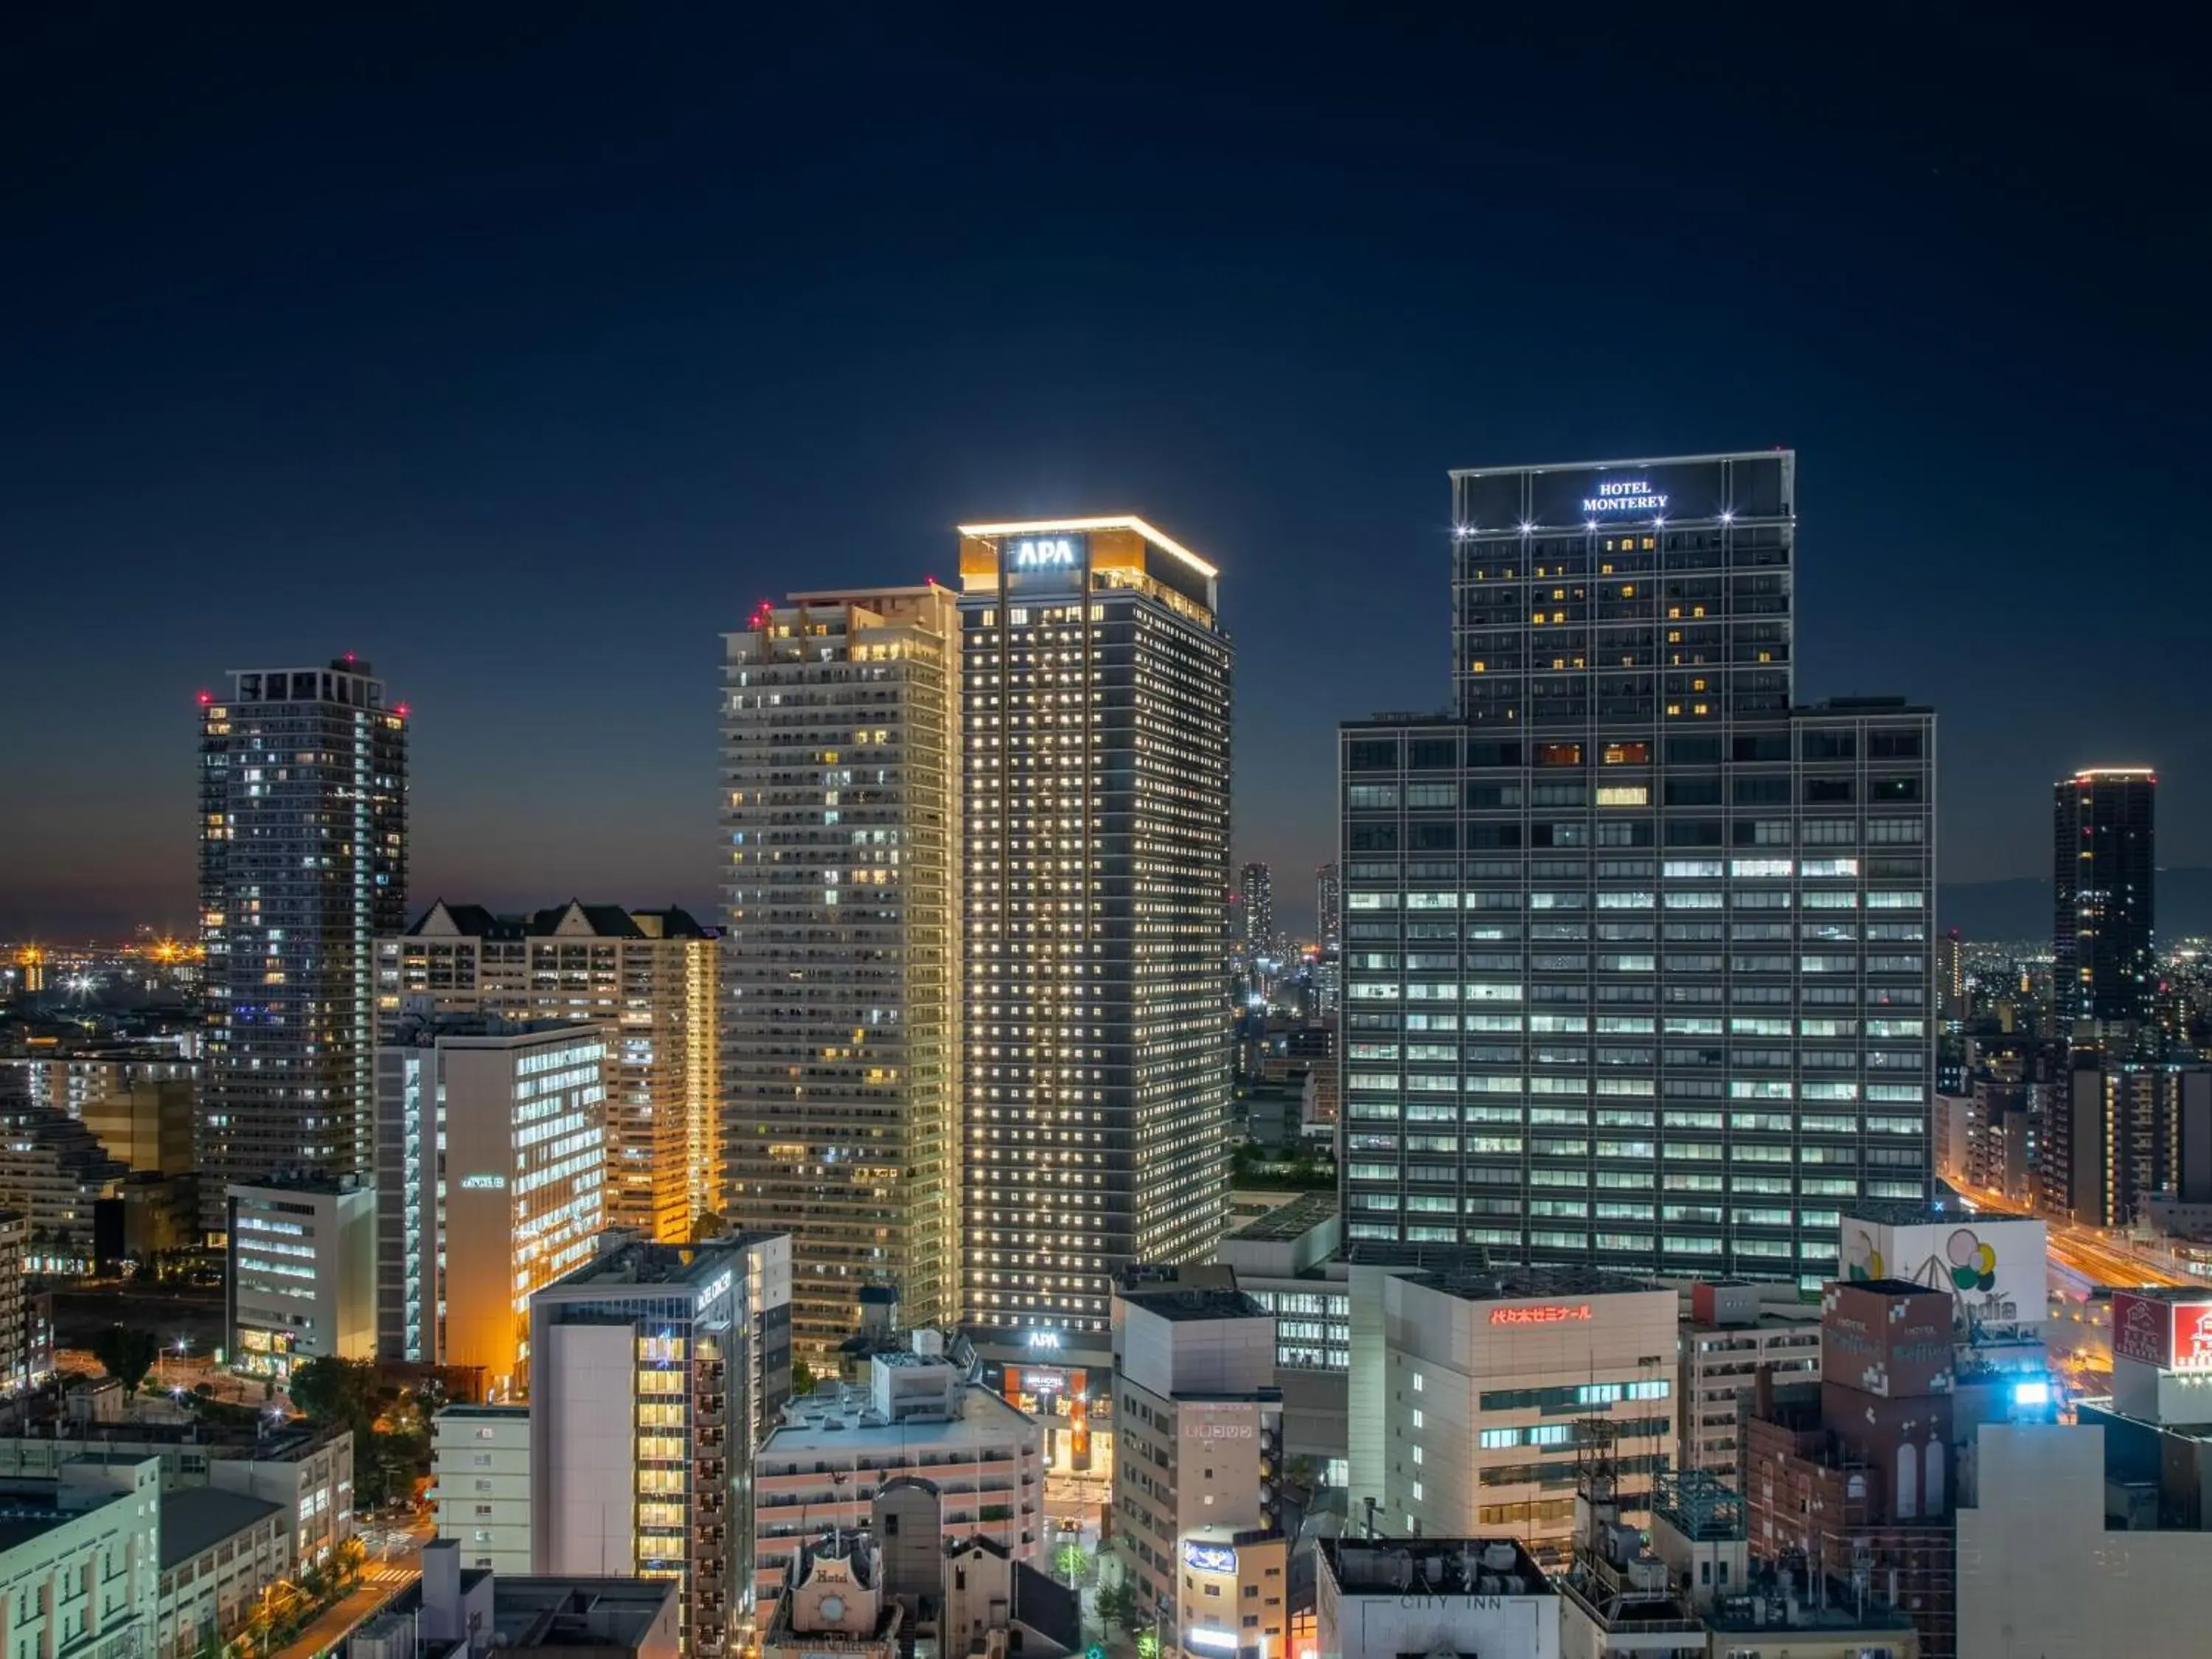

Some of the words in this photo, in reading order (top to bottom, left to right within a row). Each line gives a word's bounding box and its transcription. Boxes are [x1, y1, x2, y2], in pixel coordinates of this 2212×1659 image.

[1600, 481, 1651, 495] HOTEL
[1583, 495, 1669, 511] MONTEREY
[1018, 540, 1073, 565] APA
[1491, 1304, 1592, 1325] 代々木ゼミナール
[1029, 1332, 1060, 1349] APA
[1402, 1596, 1448, 1610] CITY
[1467, 1596, 1501, 1610] INN
